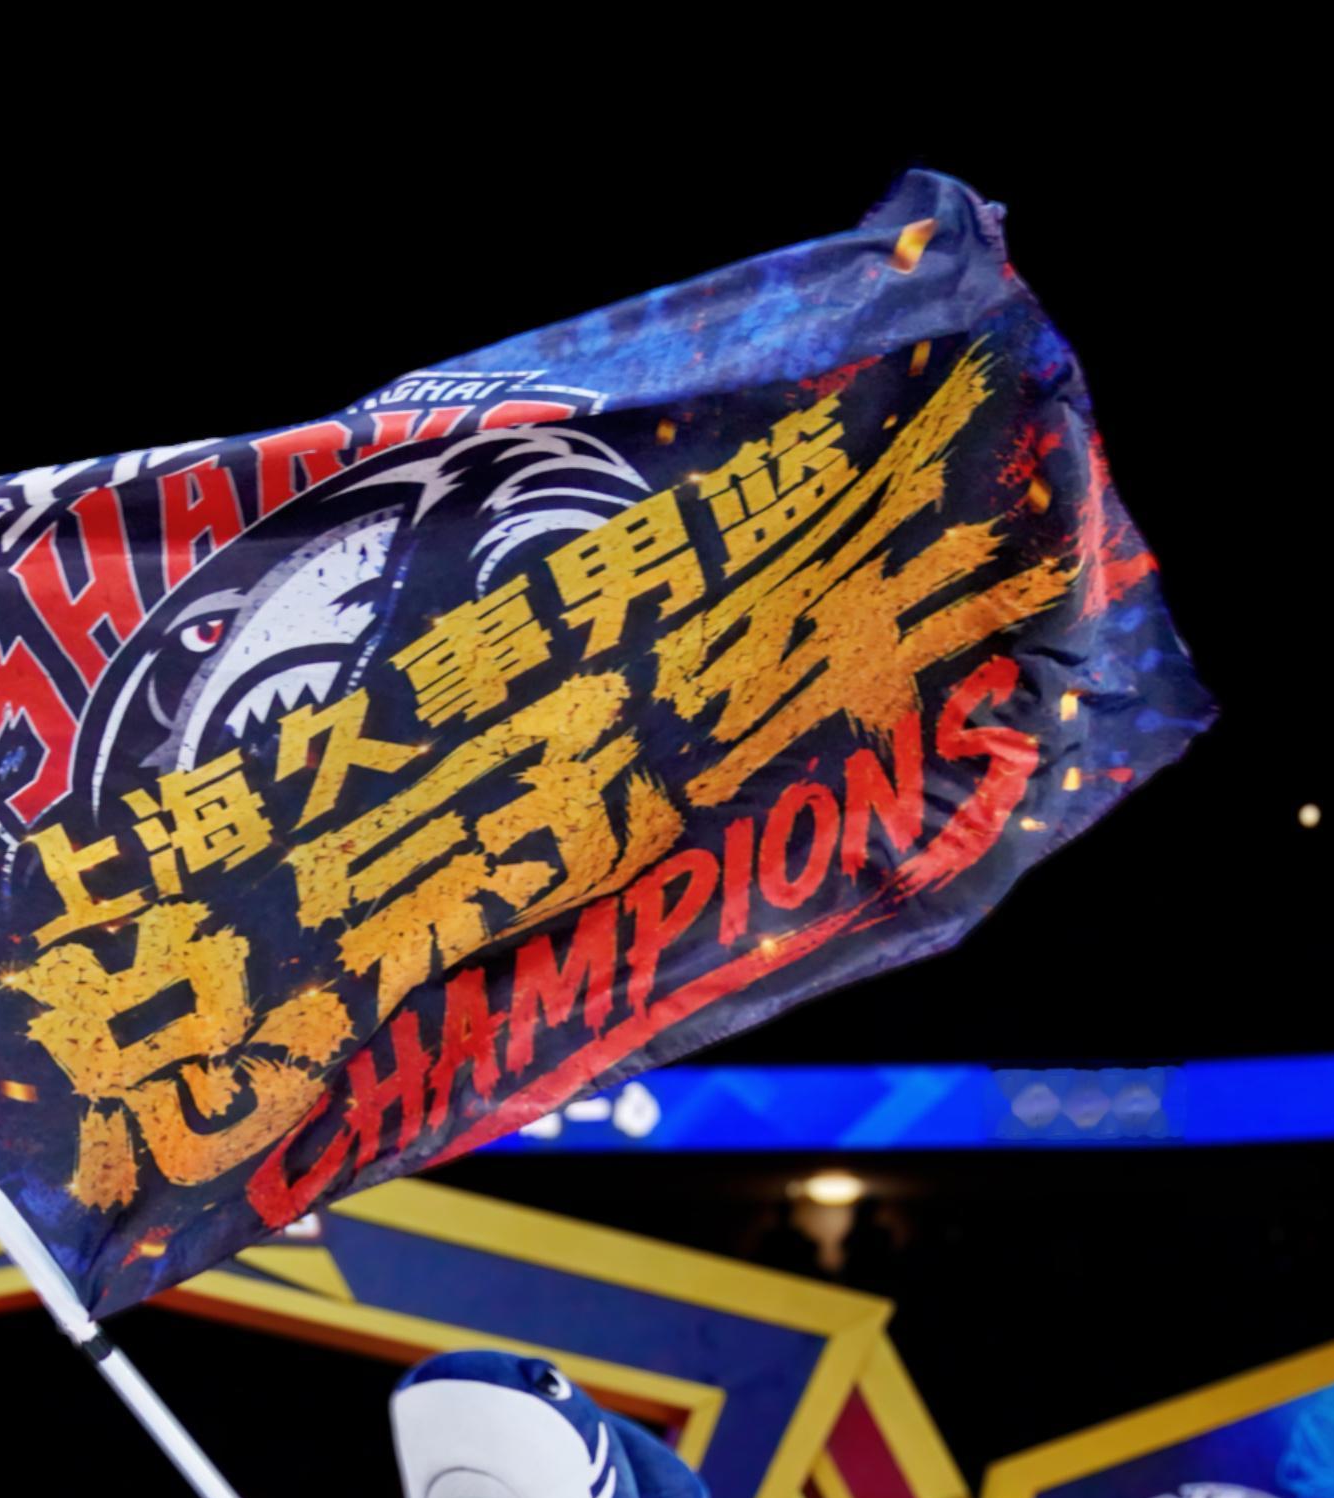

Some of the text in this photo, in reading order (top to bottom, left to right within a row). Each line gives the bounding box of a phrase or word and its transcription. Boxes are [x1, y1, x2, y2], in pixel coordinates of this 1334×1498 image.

[7, 332, 1079, 1212] 总冠军
[21, 394, 859, 946] 上海久事男篮
[247, 652, 1039, 1230] CHAMPIONS
